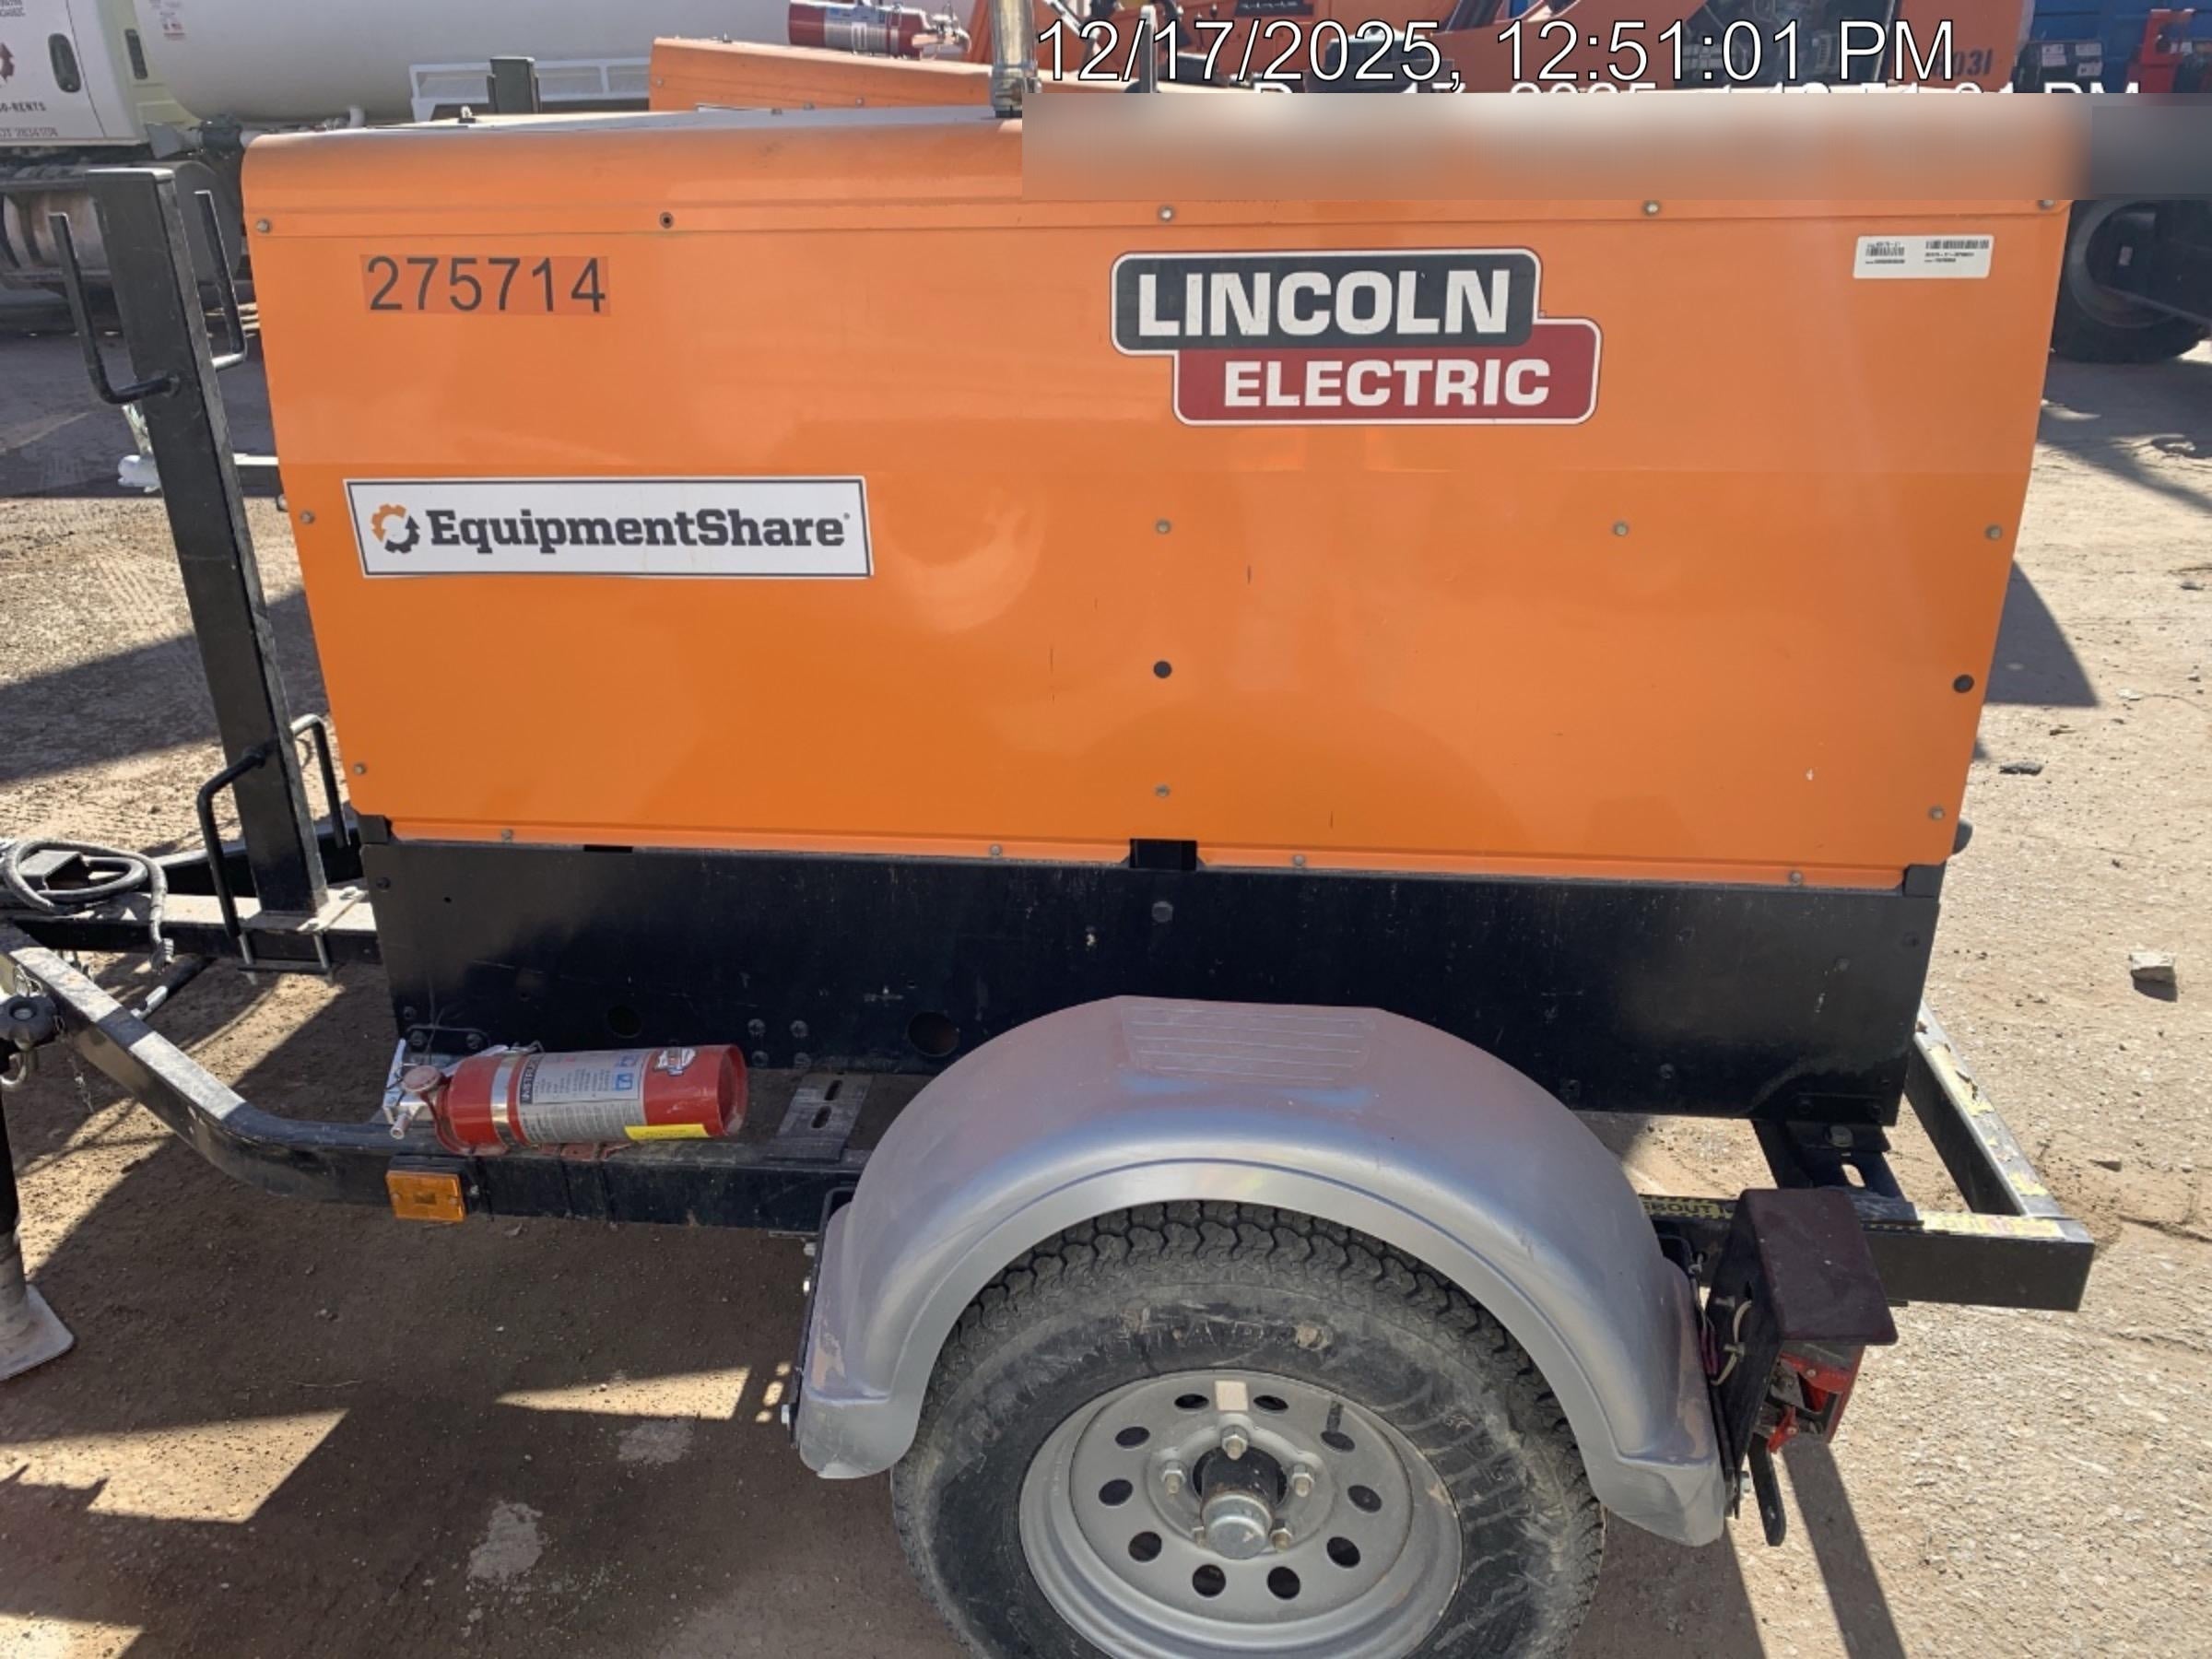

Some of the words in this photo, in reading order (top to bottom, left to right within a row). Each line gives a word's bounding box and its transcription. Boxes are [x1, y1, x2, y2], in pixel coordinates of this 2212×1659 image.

[367, 255, 607, 314] 275714
[1137, 268, 1512, 337] LINCOLN
[1223, 358, 1552, 407] ELECTRIC
[426, 508, 846, 554] EquipmentShare
